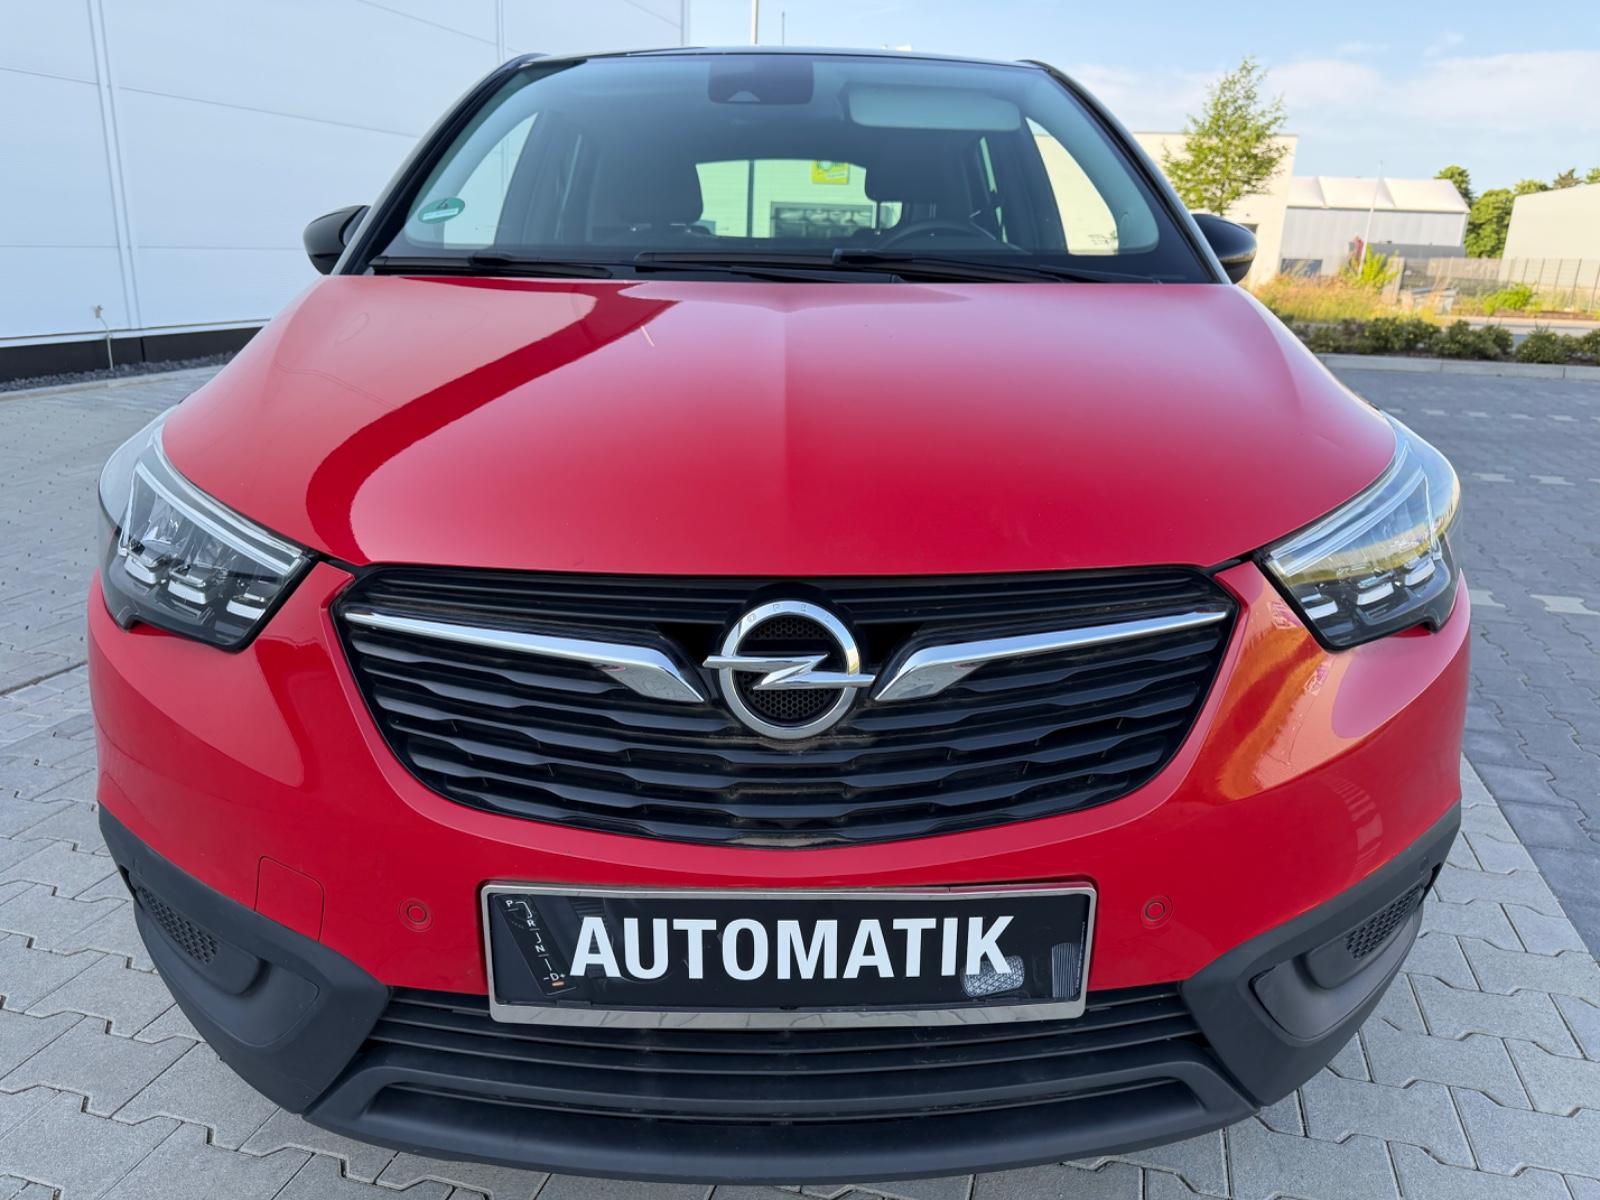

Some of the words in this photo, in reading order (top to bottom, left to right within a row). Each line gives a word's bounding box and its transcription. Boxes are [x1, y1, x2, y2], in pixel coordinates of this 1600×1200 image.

[527, 919, 536, 927] R
[535, 945, 545, 953] N
[569, 915, 1014, 981] AUTOMATIK
